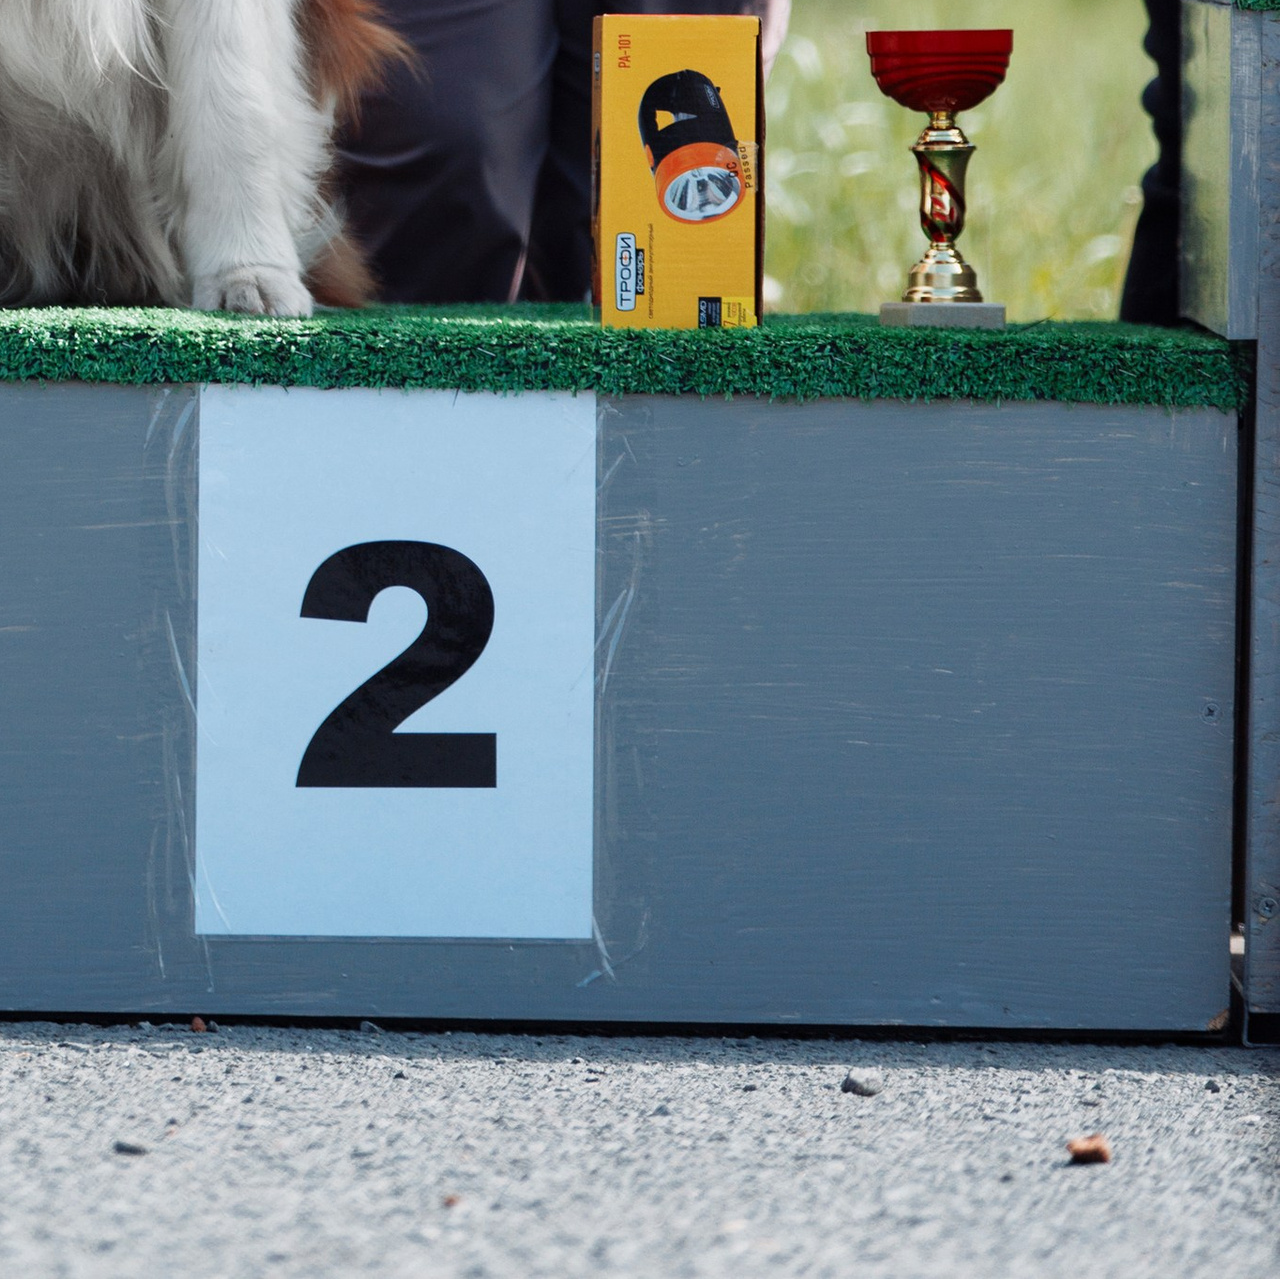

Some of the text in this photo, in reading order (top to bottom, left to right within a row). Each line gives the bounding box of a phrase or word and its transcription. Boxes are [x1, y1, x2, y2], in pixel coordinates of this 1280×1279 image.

[618, 34, 631, 69] PA-101
[738, 146, 753, 188] Passed
[619, 237, 633, 307] ТРОФИ
[296, 540, 497, 788] 2
